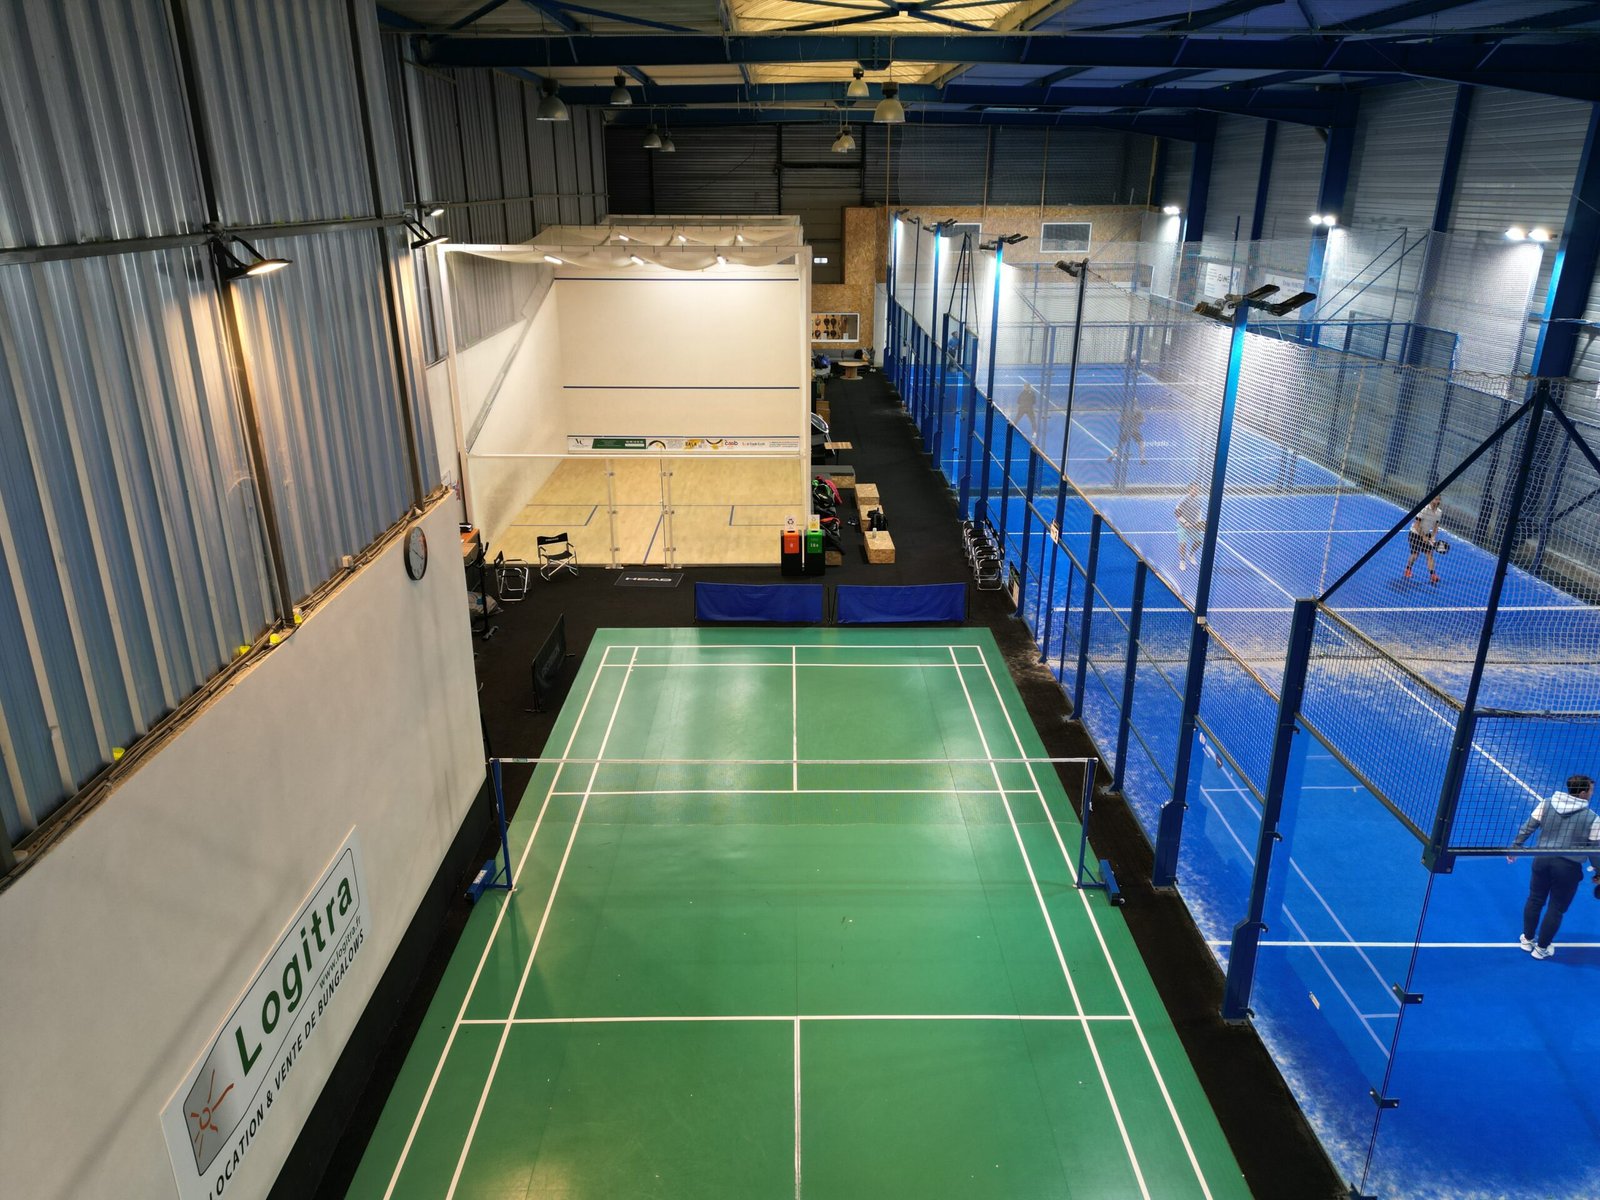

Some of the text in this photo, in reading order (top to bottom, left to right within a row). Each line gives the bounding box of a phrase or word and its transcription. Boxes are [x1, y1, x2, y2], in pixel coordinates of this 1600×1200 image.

[235, 877, 352, 1077] Logitra
[266, 1090, 273, 1108] &
[275, 1034, 303, 1090] VENTE
[305, 1011, 316, 1039] DE
[318, 928, 364, 1017] BUNGALOWS
[319, 915, 362, 990] www.logitra.fr
